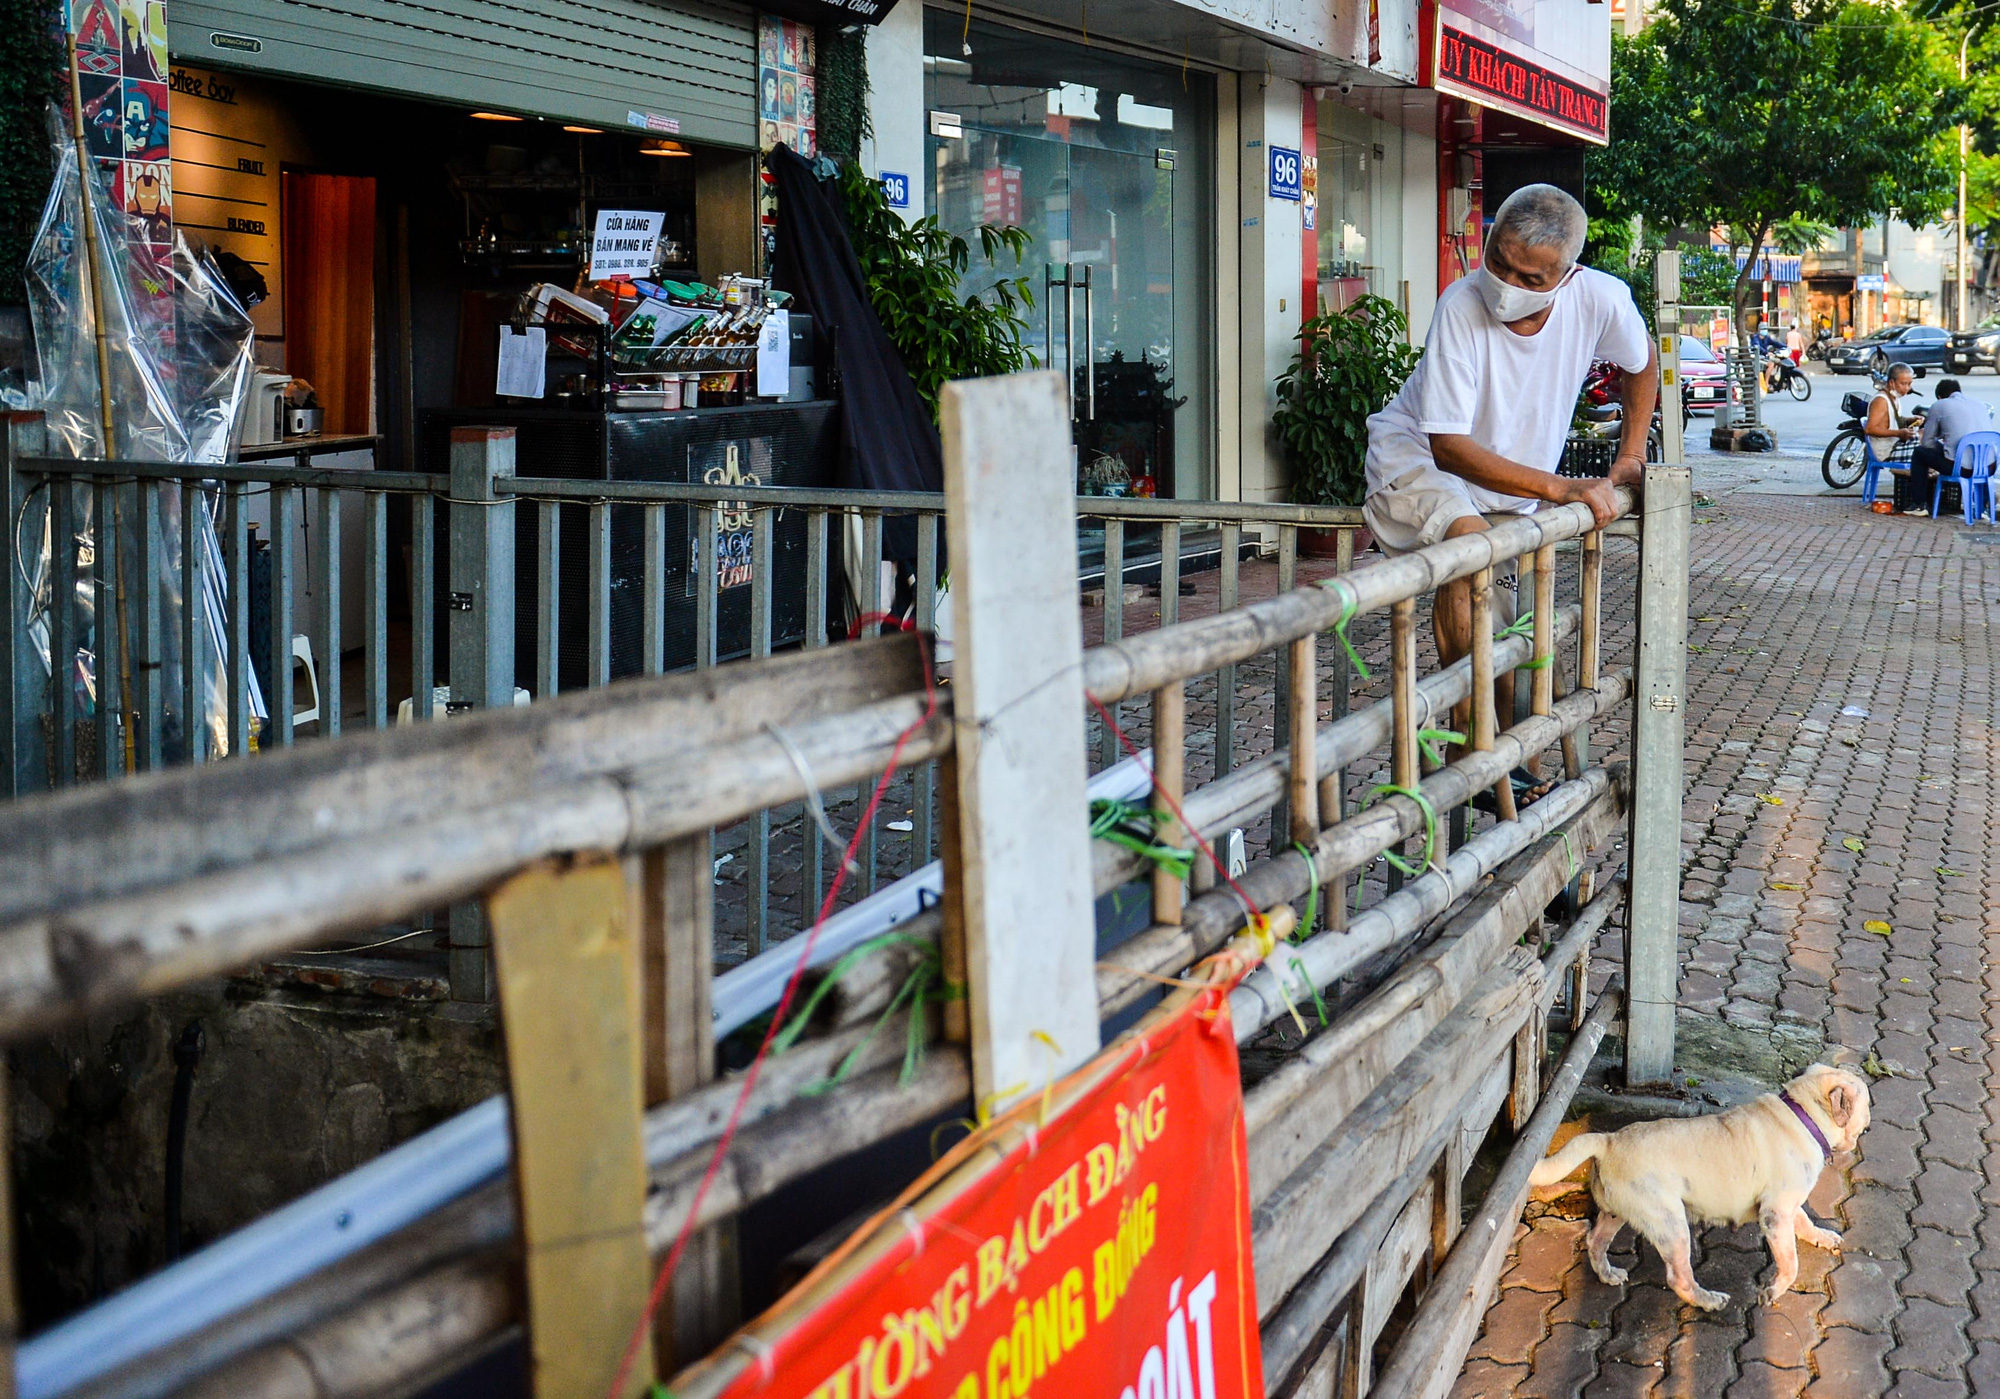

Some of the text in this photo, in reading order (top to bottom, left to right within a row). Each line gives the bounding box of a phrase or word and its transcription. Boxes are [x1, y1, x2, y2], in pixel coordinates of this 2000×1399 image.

[1558, 84, 1598, 128] TRANG
[125, 162, 171, 183] IRON
[238, 158, 264, 174] FRUIT
[1275, 155, 1297, 185] 96
[126, 182, 171, 207] MN
[886, 178, 904, 201] 96
[228, 217, 265, 234] BLENDED
[606, 212, 650, 231] CỬA HÀNG
[596, 236, 613, 252] BÁN
[614, 239, 640, 252] MANG
[975, 1161, 1082, 1310] BẠCH
[1093, 1181, 1159, 1324] ĐỒNG
